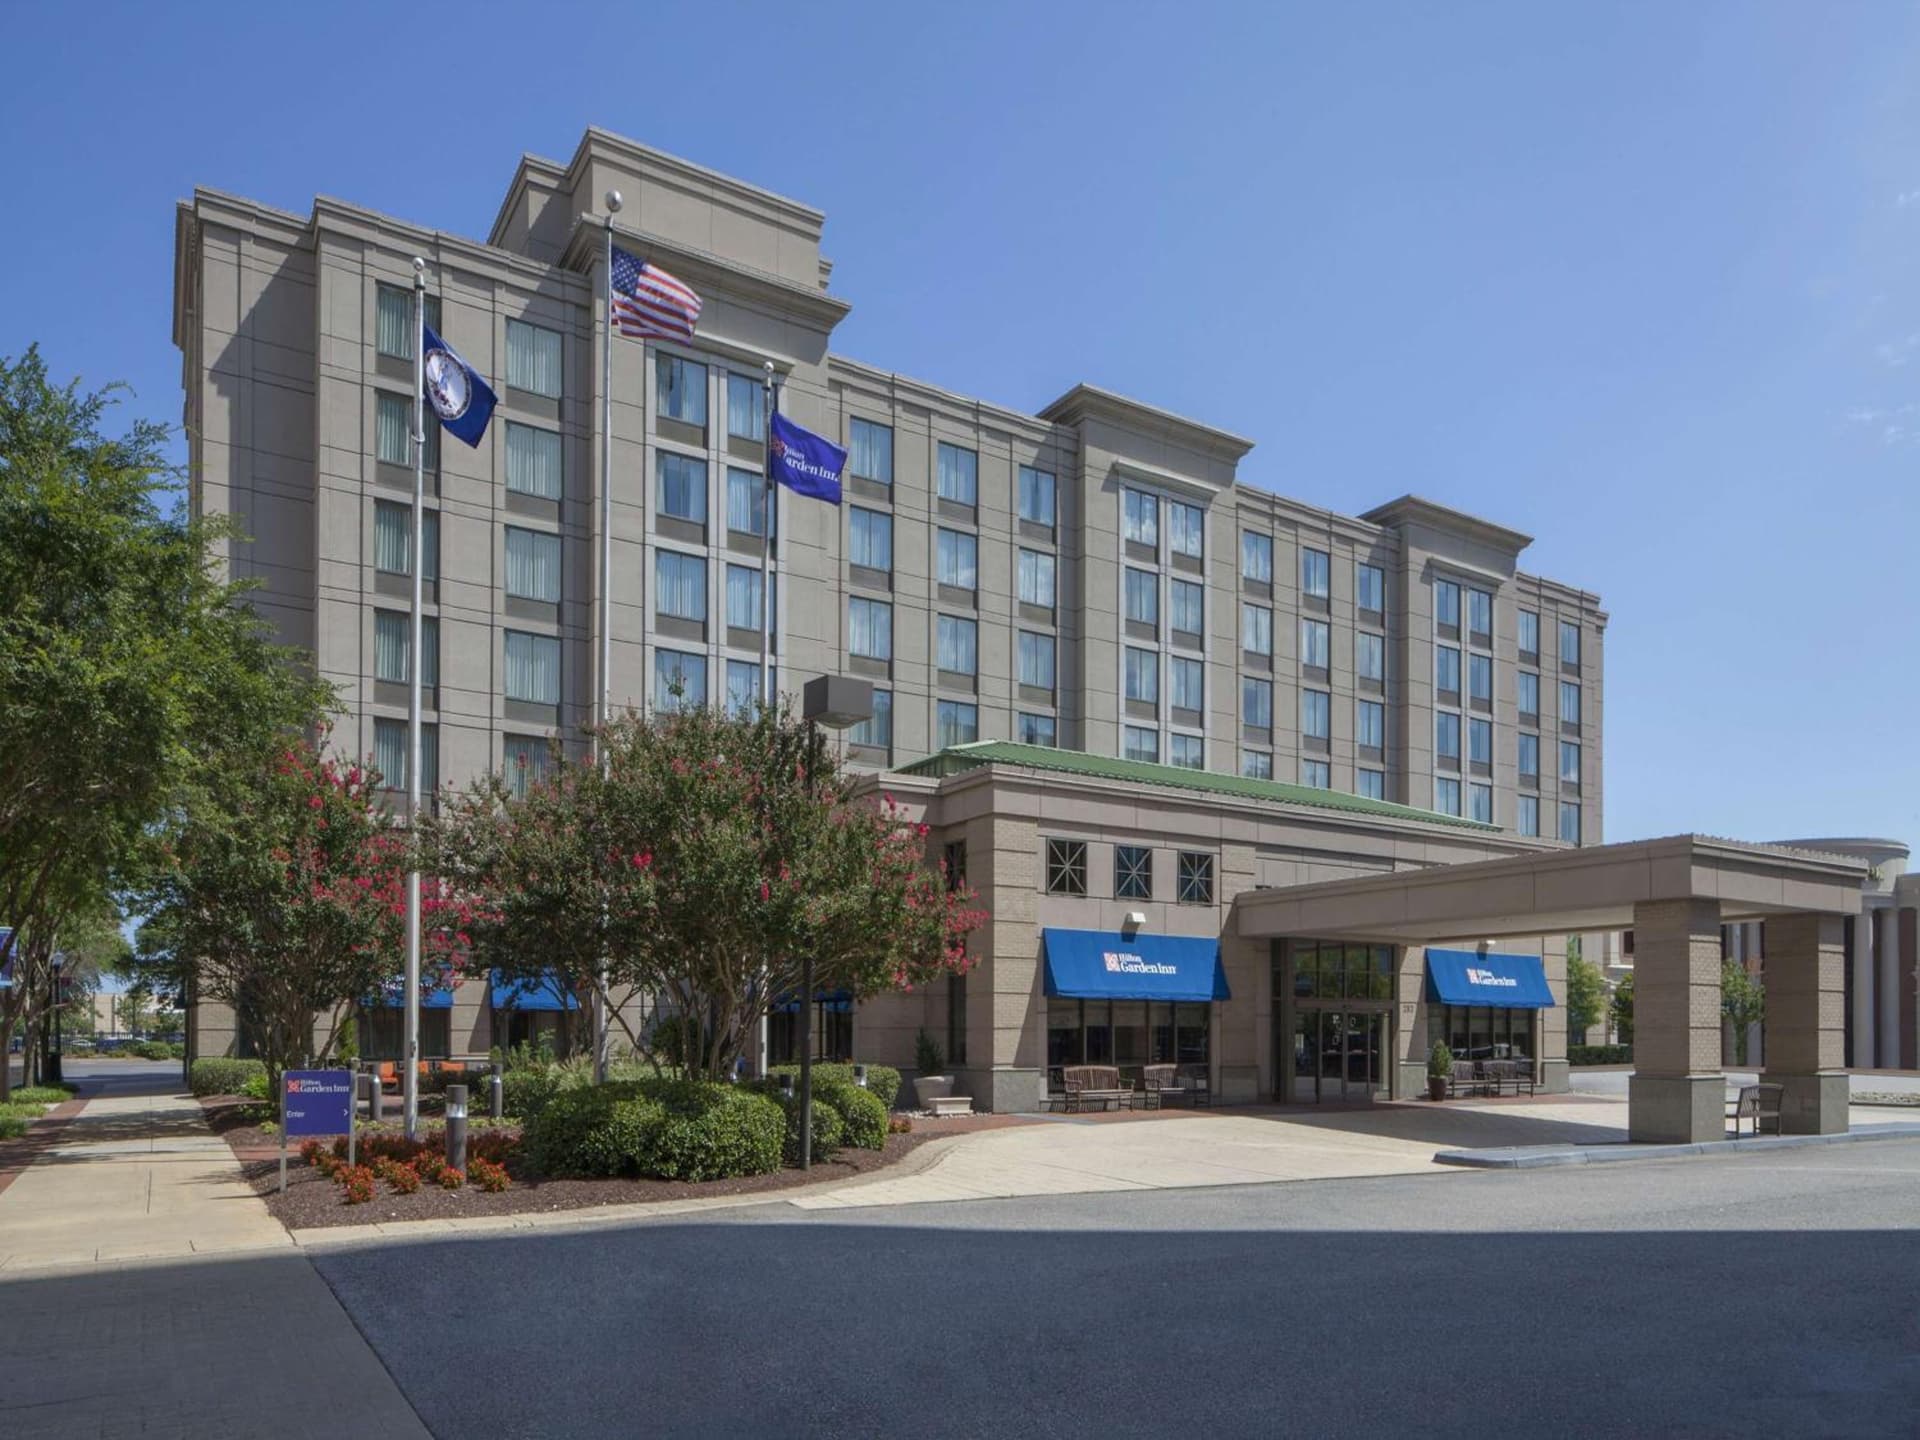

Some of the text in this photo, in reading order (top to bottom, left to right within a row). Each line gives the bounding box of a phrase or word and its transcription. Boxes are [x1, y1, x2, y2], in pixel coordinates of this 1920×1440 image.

[785, 456, 818, 476] arden
[1120, 961, 1177, 975] Garden Inn
[300, 1080, 350, 1093] Garden Inn
[286, 1110, 305, 1118] Enter
